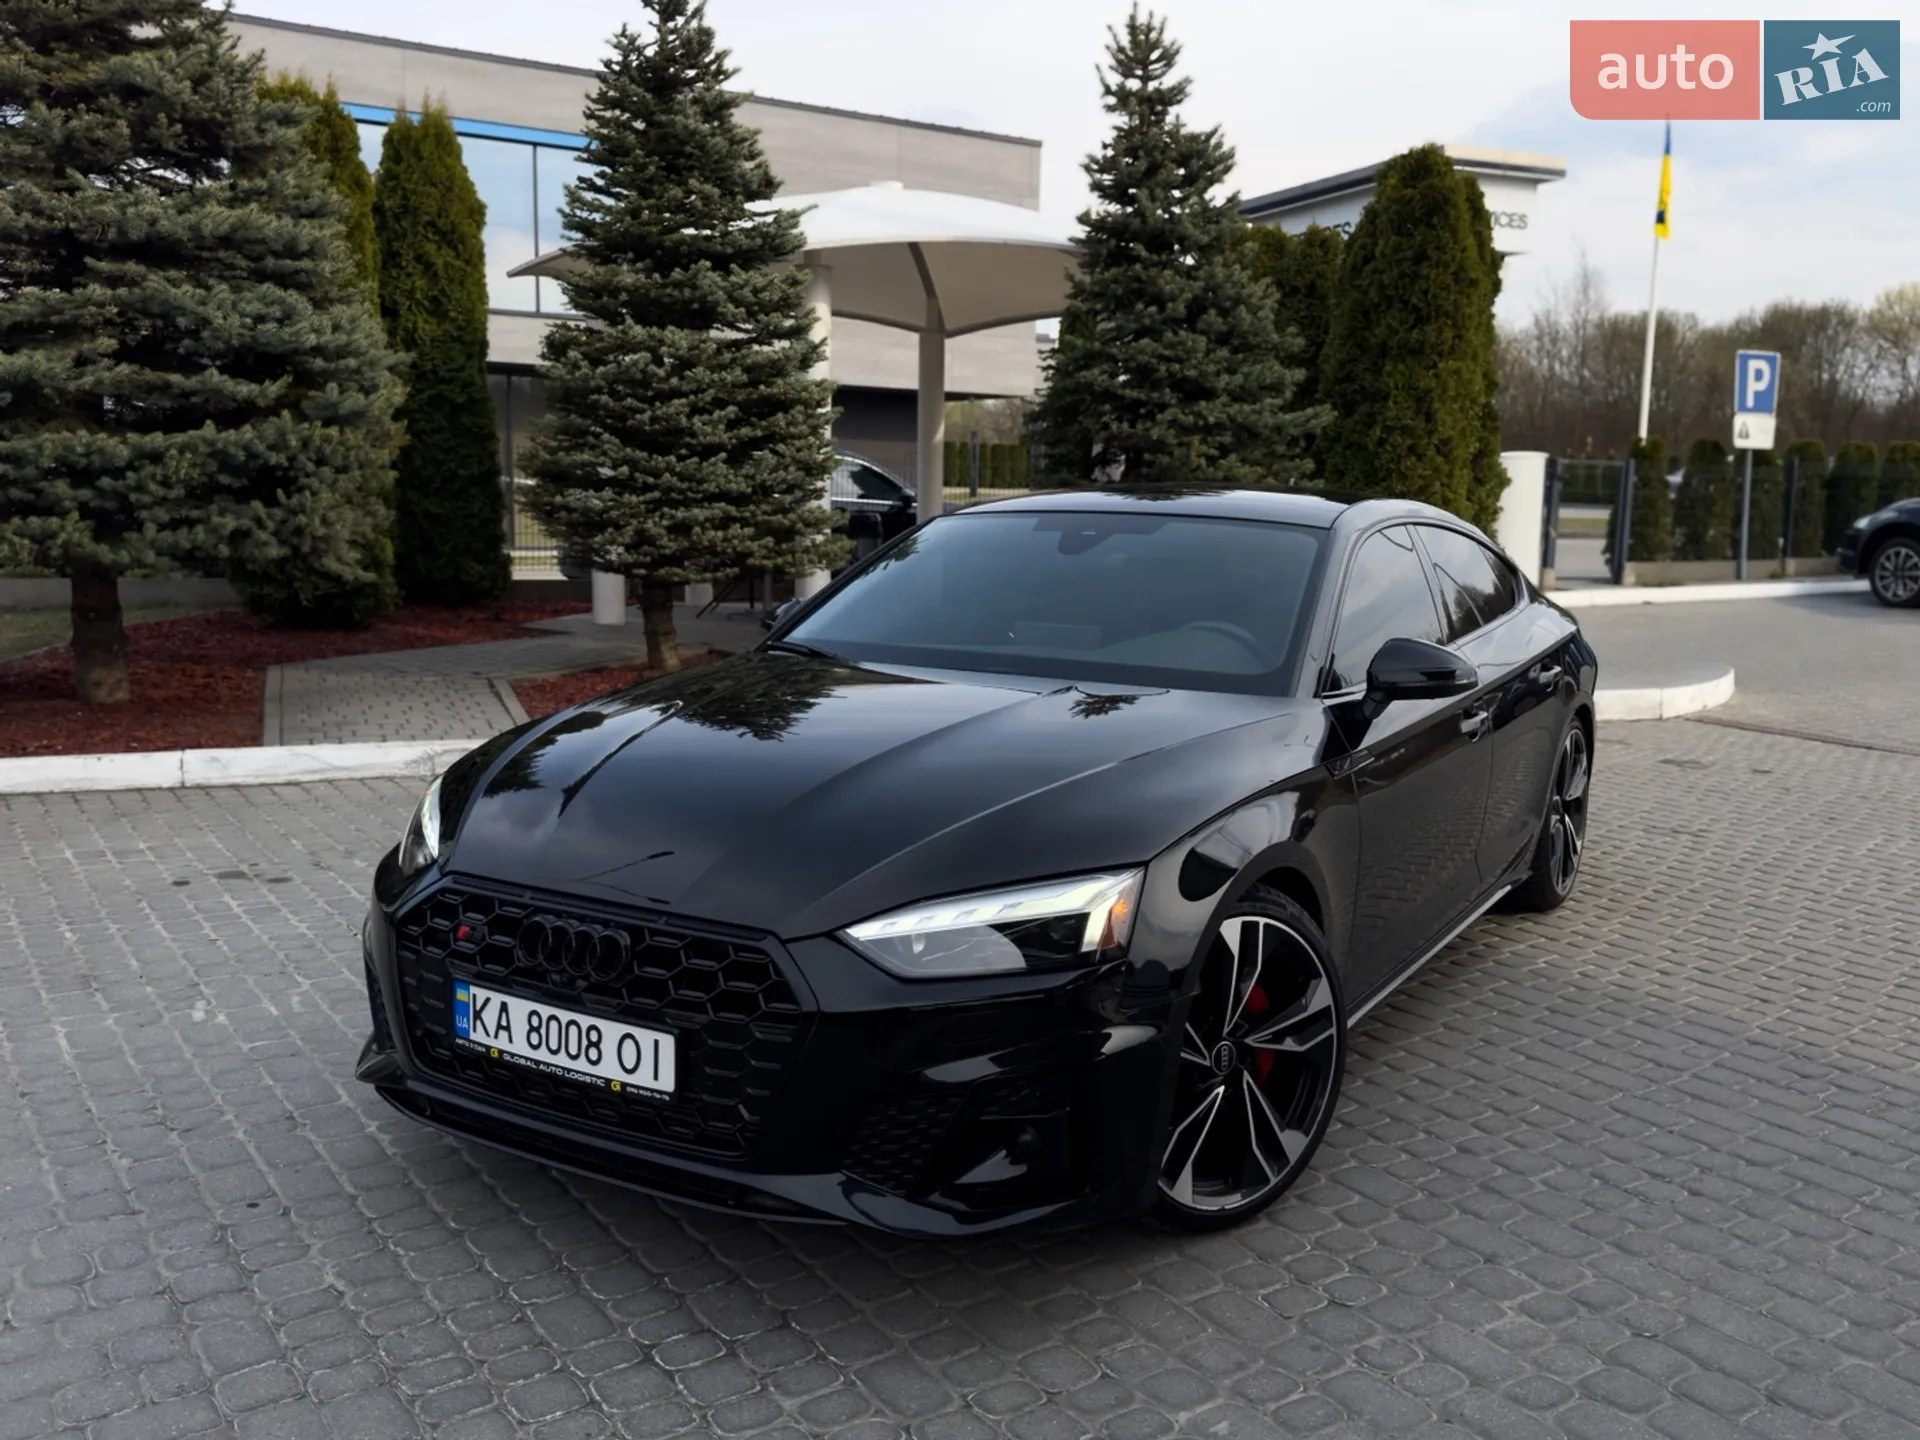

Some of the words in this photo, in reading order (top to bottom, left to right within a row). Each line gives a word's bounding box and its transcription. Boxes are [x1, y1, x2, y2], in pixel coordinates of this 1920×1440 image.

[1489, 210, 1529, 230] ICES
[1746, 359, 1771, 409] P
[456, 1014, 469, 1030] UA
[472, 993, 513, 1044] KA
[526, 1009, 603, 1066] 8008
[617, 1032, 660, 1082] OI
[502, 1053, 538, 1069] GLOBAL
[538, 1064, 563, 1075] AUTO
[564, 1070, 606, 1087] LOGISTIC
